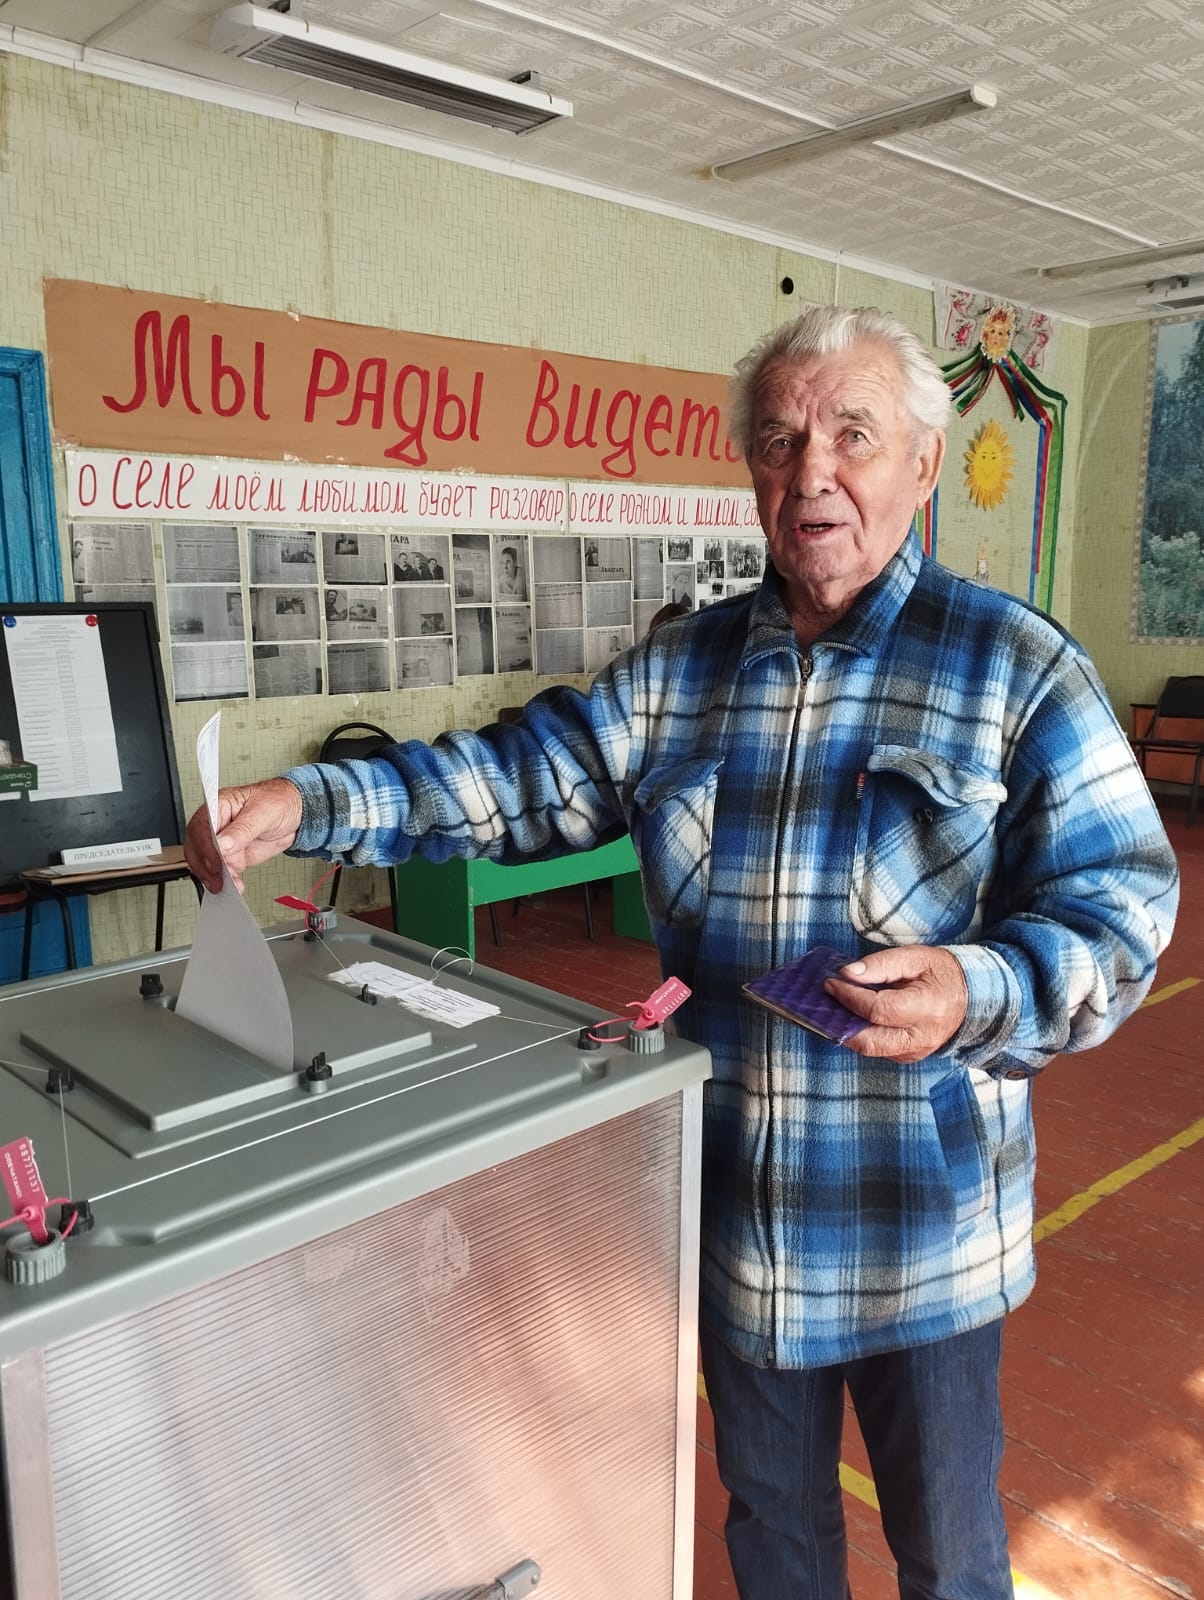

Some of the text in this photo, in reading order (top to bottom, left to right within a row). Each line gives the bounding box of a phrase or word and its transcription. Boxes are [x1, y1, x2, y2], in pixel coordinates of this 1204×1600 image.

[102, 310, 270, 421] Мы
[206, 472, 286, 512] моём
[297, 479, 408, 514] любимом
[419, 481, 477, 518] будет
[581, 492, 614, 523] селе
[676, 497, 689, 526] и
